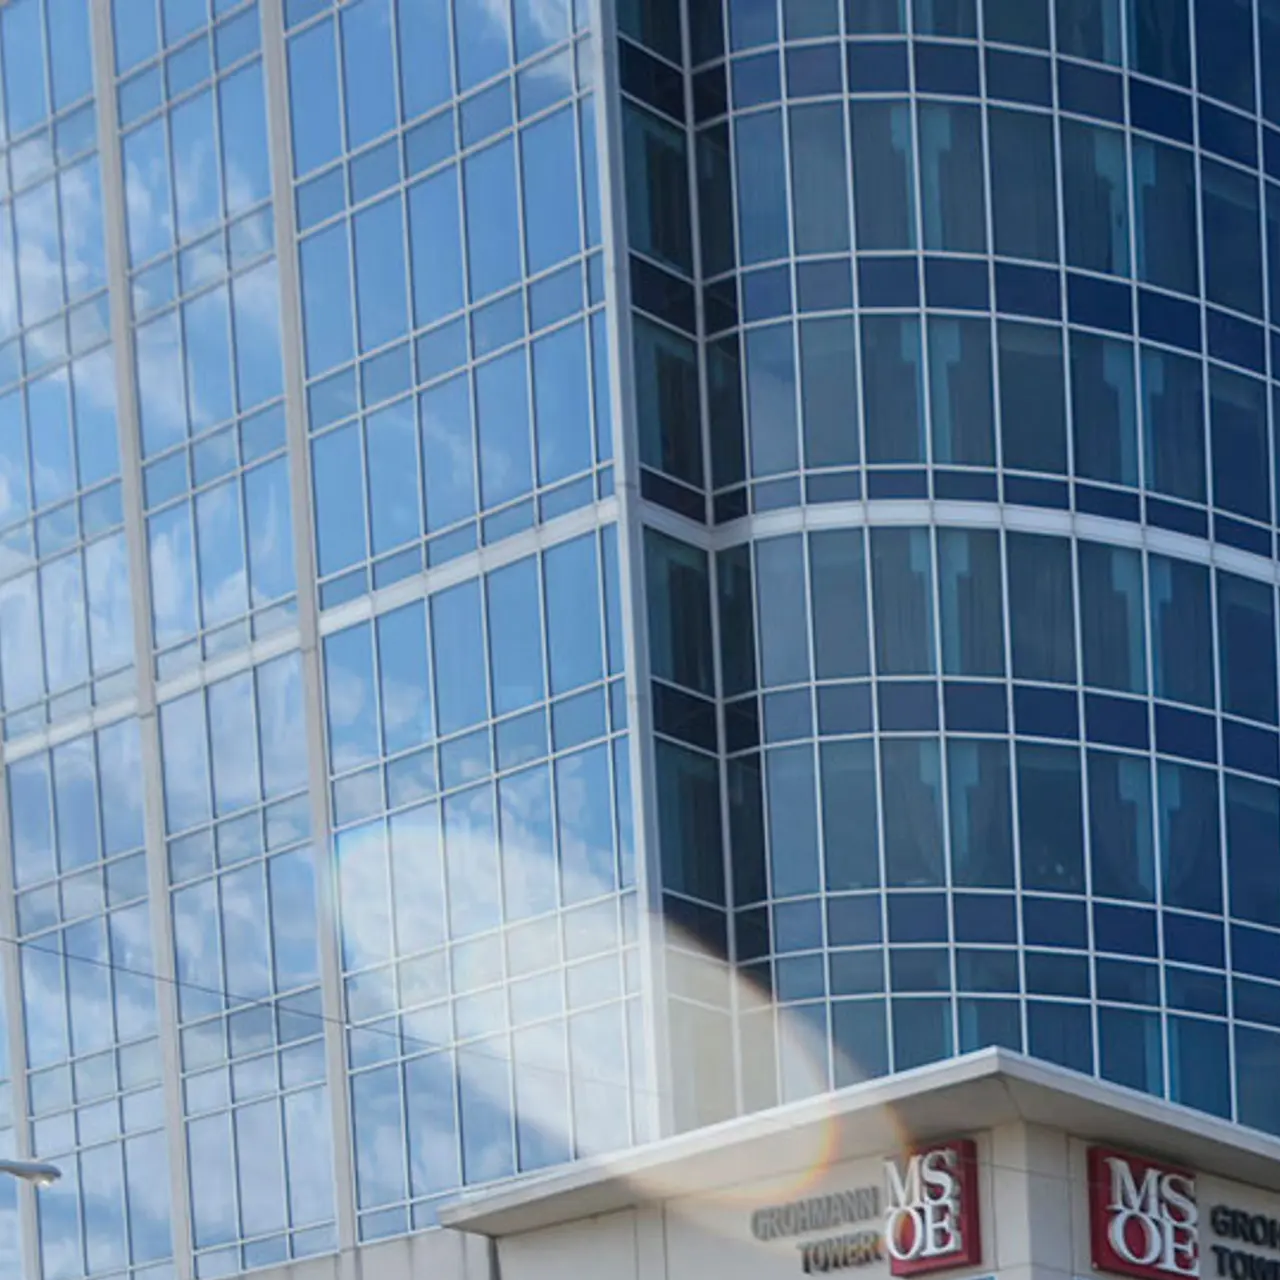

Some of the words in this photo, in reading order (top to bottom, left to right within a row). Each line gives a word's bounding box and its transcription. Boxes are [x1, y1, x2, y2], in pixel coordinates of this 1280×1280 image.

[883, 1150, 954, 1209] MS
[1104, 1156, 1199, 1226] MS
[752, 1186, 881, 1242] GROHMANN
[885, 1202, 956, 1260] OE
[797, 1231, 884, 1275] TOWER
[1107, 1210, 1200, 1278] OE
